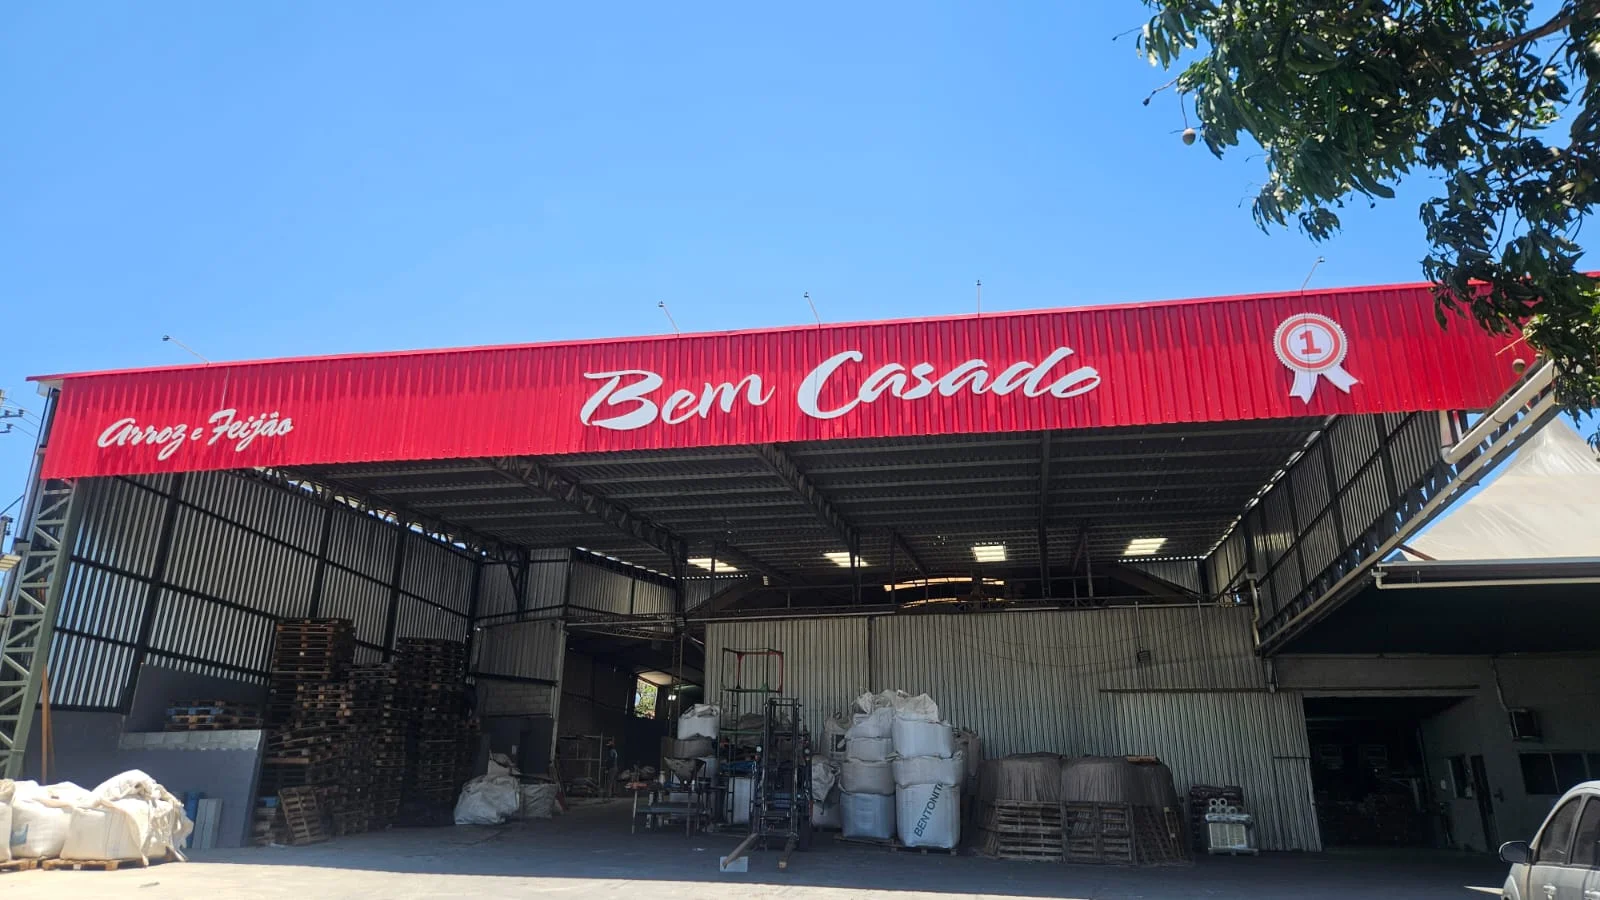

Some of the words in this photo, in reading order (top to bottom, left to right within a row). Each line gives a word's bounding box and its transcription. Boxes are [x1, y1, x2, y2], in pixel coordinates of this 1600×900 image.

[1299, 330, 1322, 355] 1
[580, 369, 776, 431] Bem
[797, 346, 1101, 420] Casado
[97, 417, 187, 461] Arroz
[190, 427, 204, 441] e
[207, 408, 294, 452] Feijão
